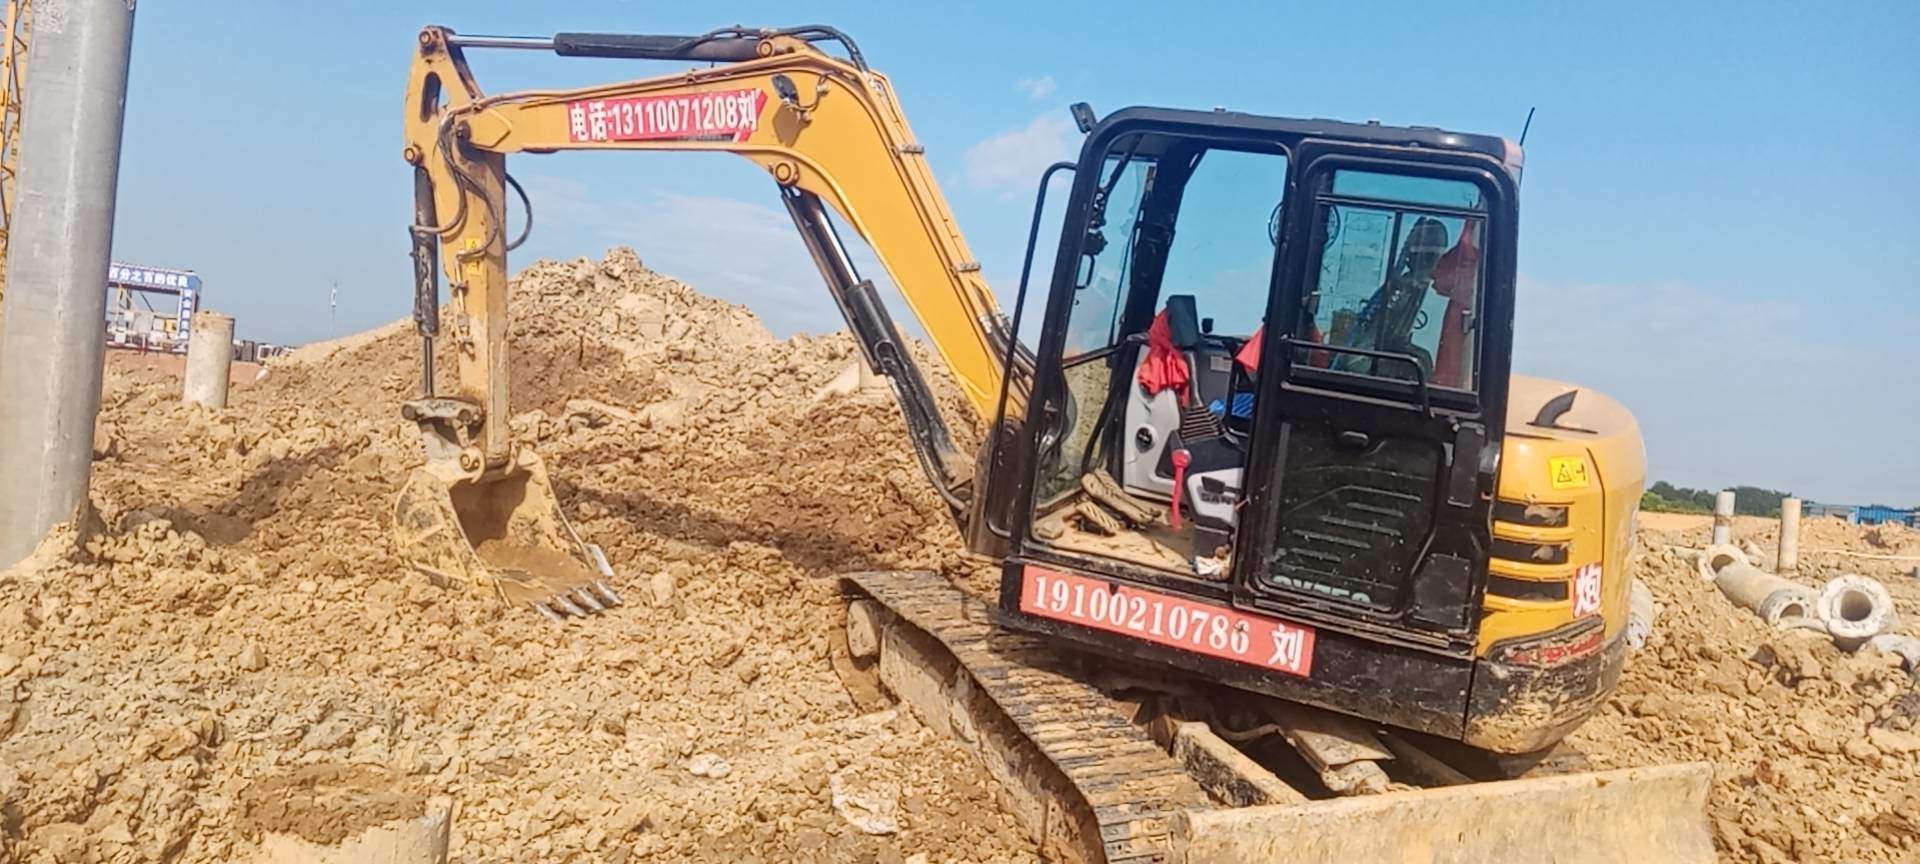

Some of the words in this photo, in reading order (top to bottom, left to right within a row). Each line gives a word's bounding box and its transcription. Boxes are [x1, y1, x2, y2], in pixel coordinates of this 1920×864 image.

[1033, 575, 1251, 655] 19100210786
[1267, 622, 1305, 672] 刘
[1574, 565, 1602, 619] 炮
